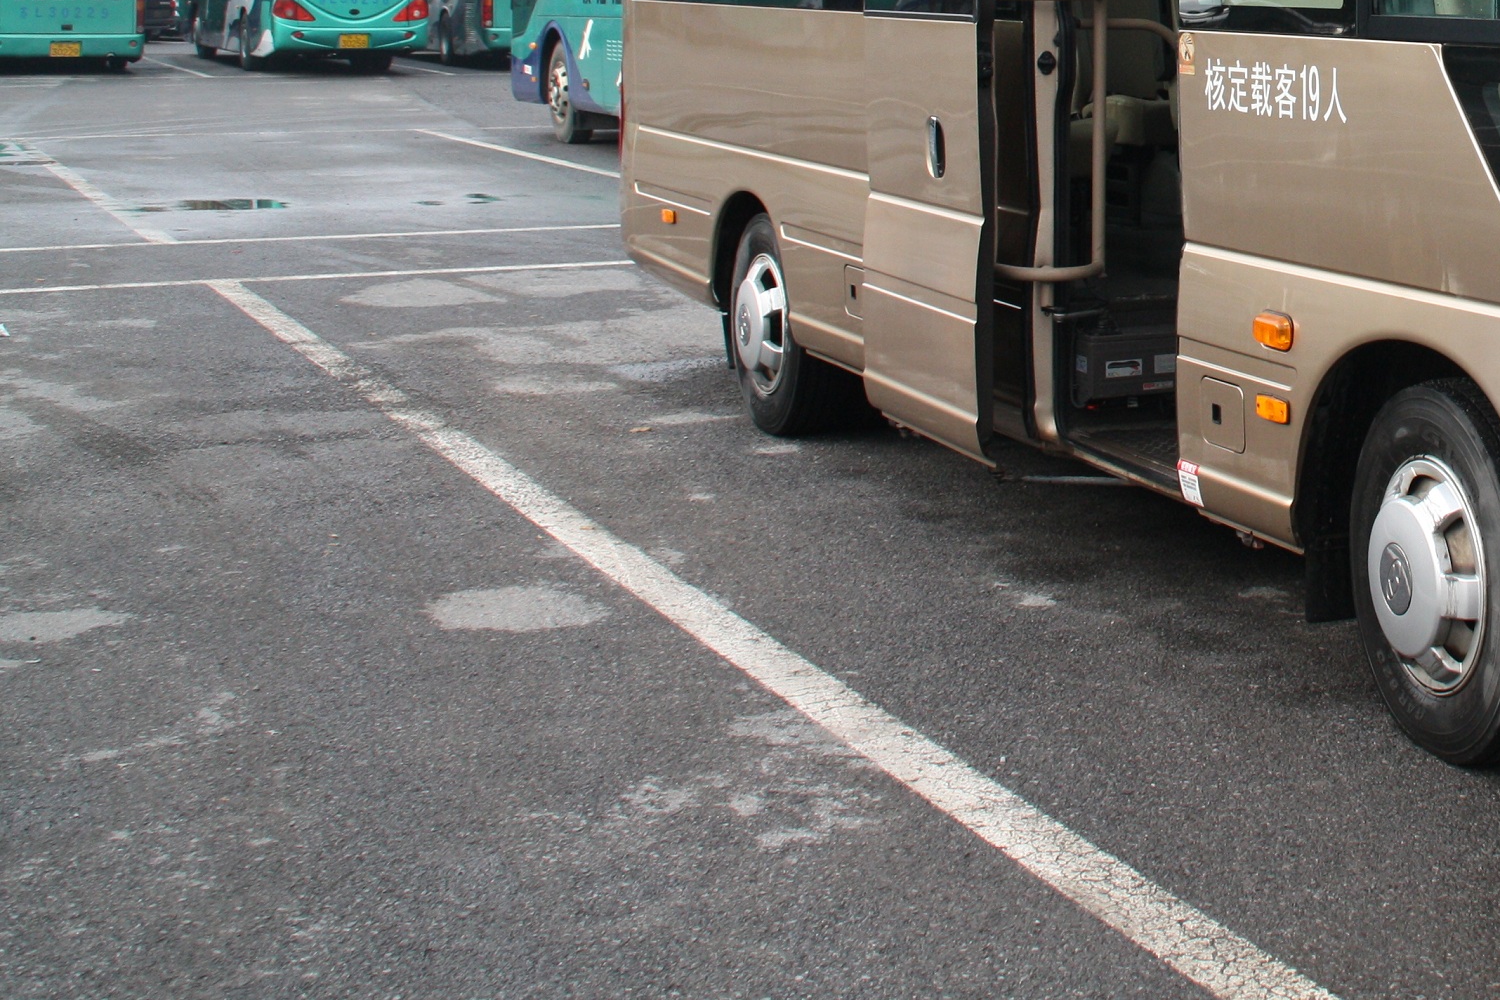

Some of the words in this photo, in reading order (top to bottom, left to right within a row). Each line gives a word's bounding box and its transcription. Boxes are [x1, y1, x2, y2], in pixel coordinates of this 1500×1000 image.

[1204, 58, 1348, 124] 核定载客19人
